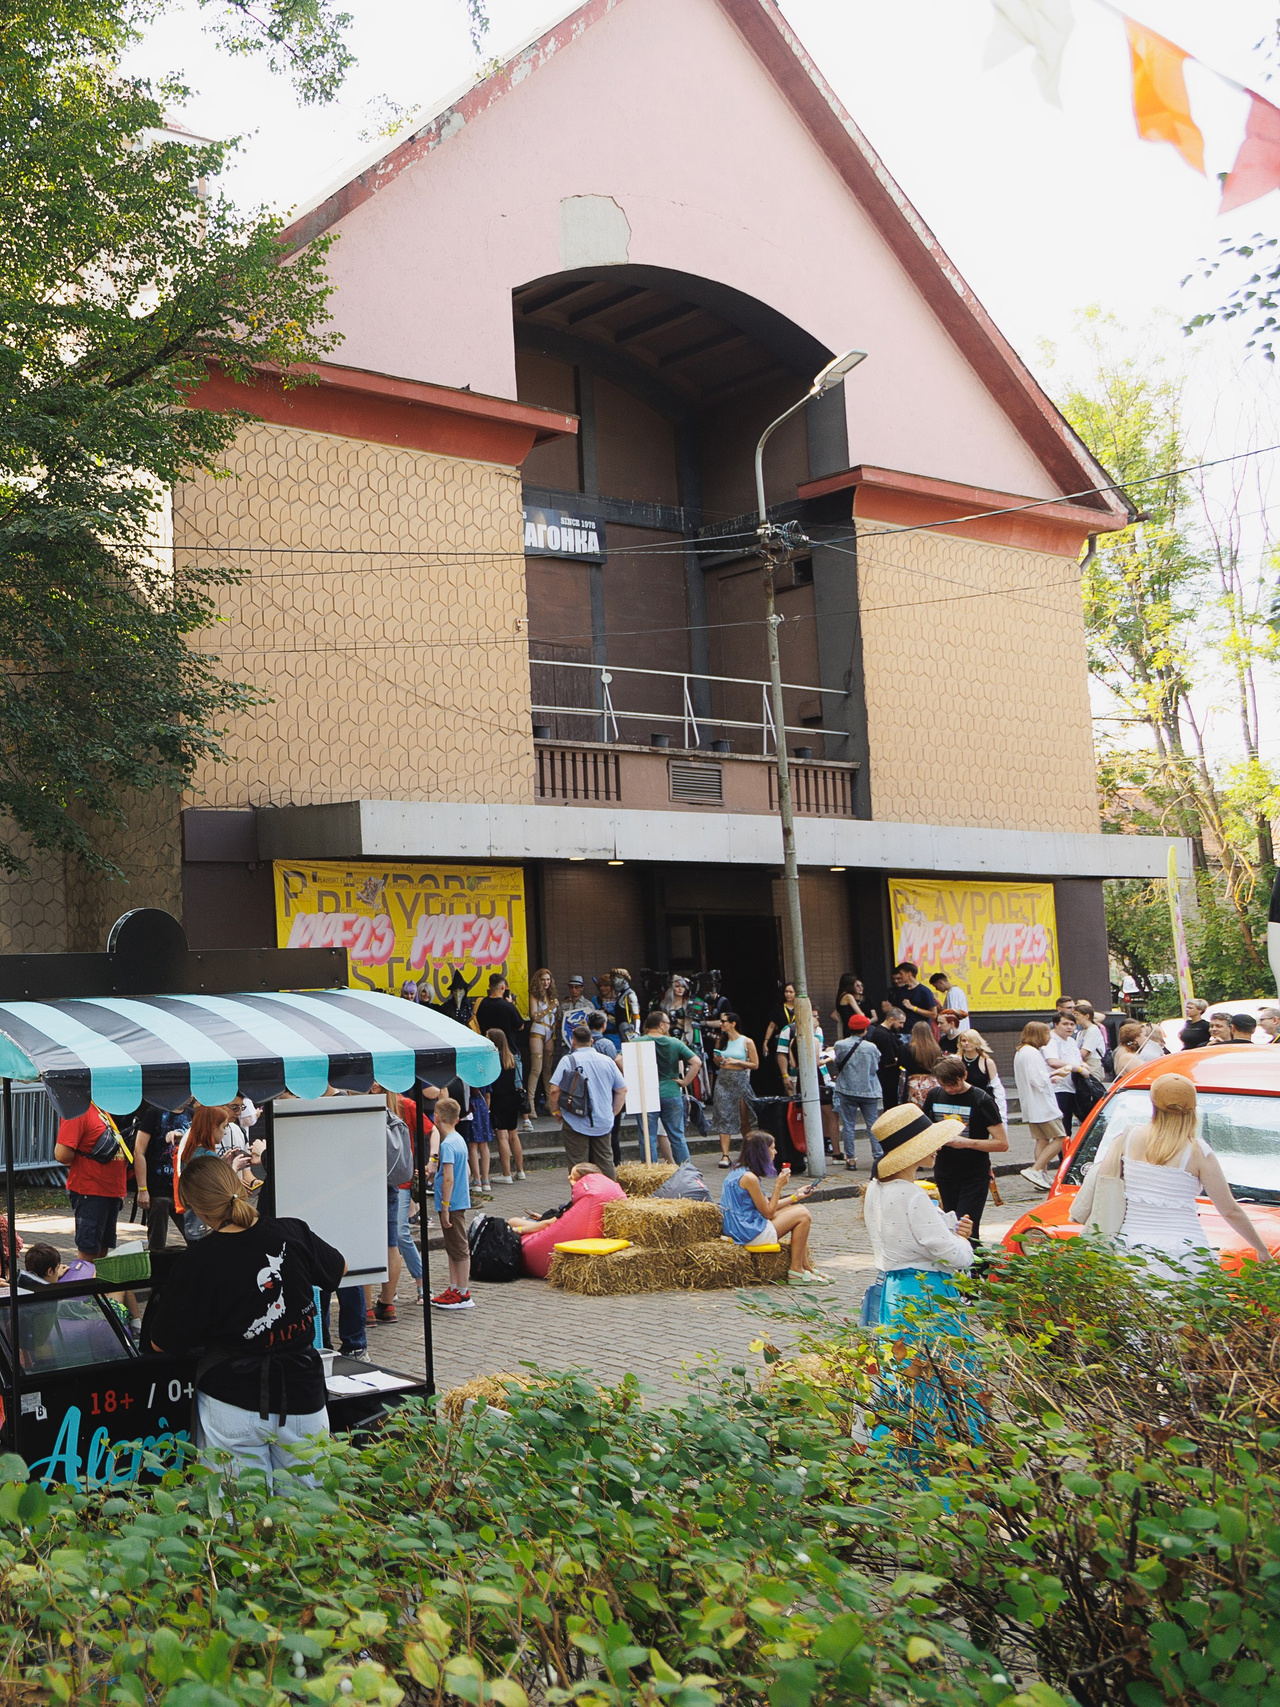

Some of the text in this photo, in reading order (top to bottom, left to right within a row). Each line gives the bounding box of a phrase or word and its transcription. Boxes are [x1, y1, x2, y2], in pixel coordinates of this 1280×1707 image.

[523, 521, 600, 554] АГОНКА
[560, 516, 596, 530] SINCE 1978
[91, 1390, 134, 1415] 18+
[168, 1379, 195, 1402] 0+
